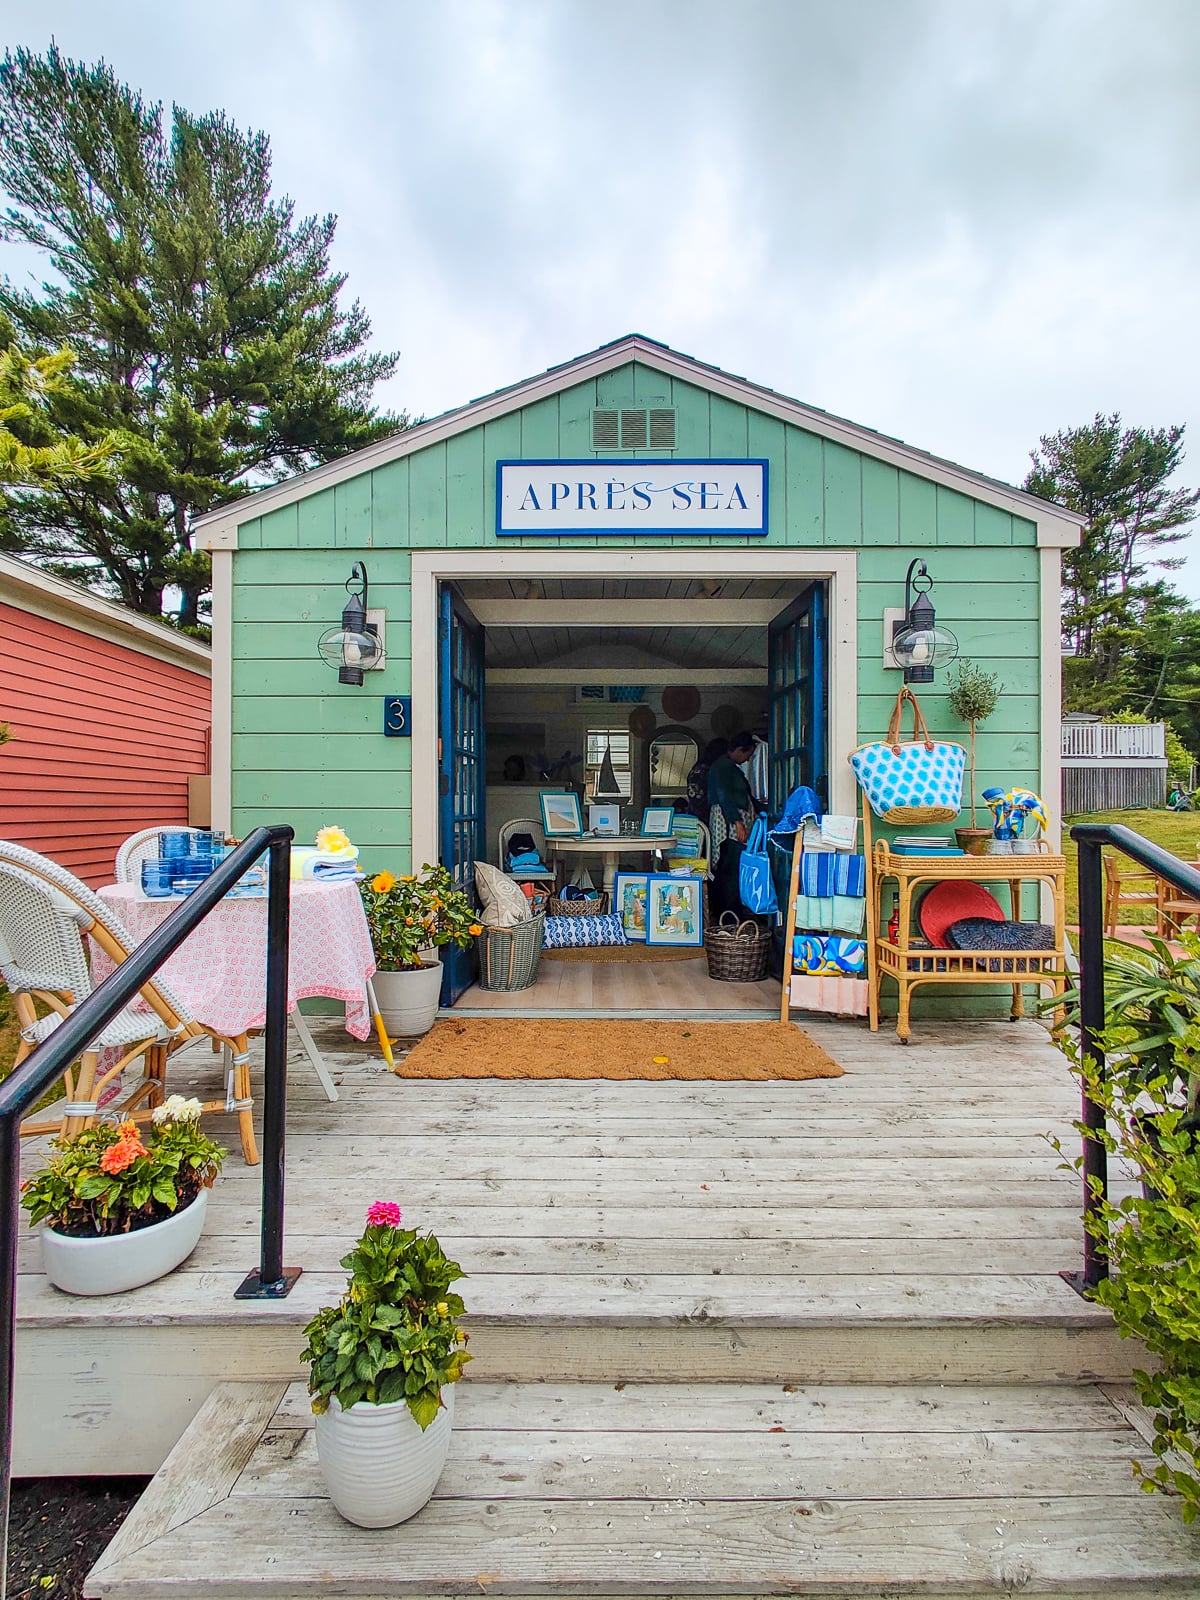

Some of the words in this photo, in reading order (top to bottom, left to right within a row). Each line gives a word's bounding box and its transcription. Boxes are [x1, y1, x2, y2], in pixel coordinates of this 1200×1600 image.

[518, 478, 653, 511] APRÈS
[672, 481, 751, 511] SEA
[387, 700, 405, 731] 3
